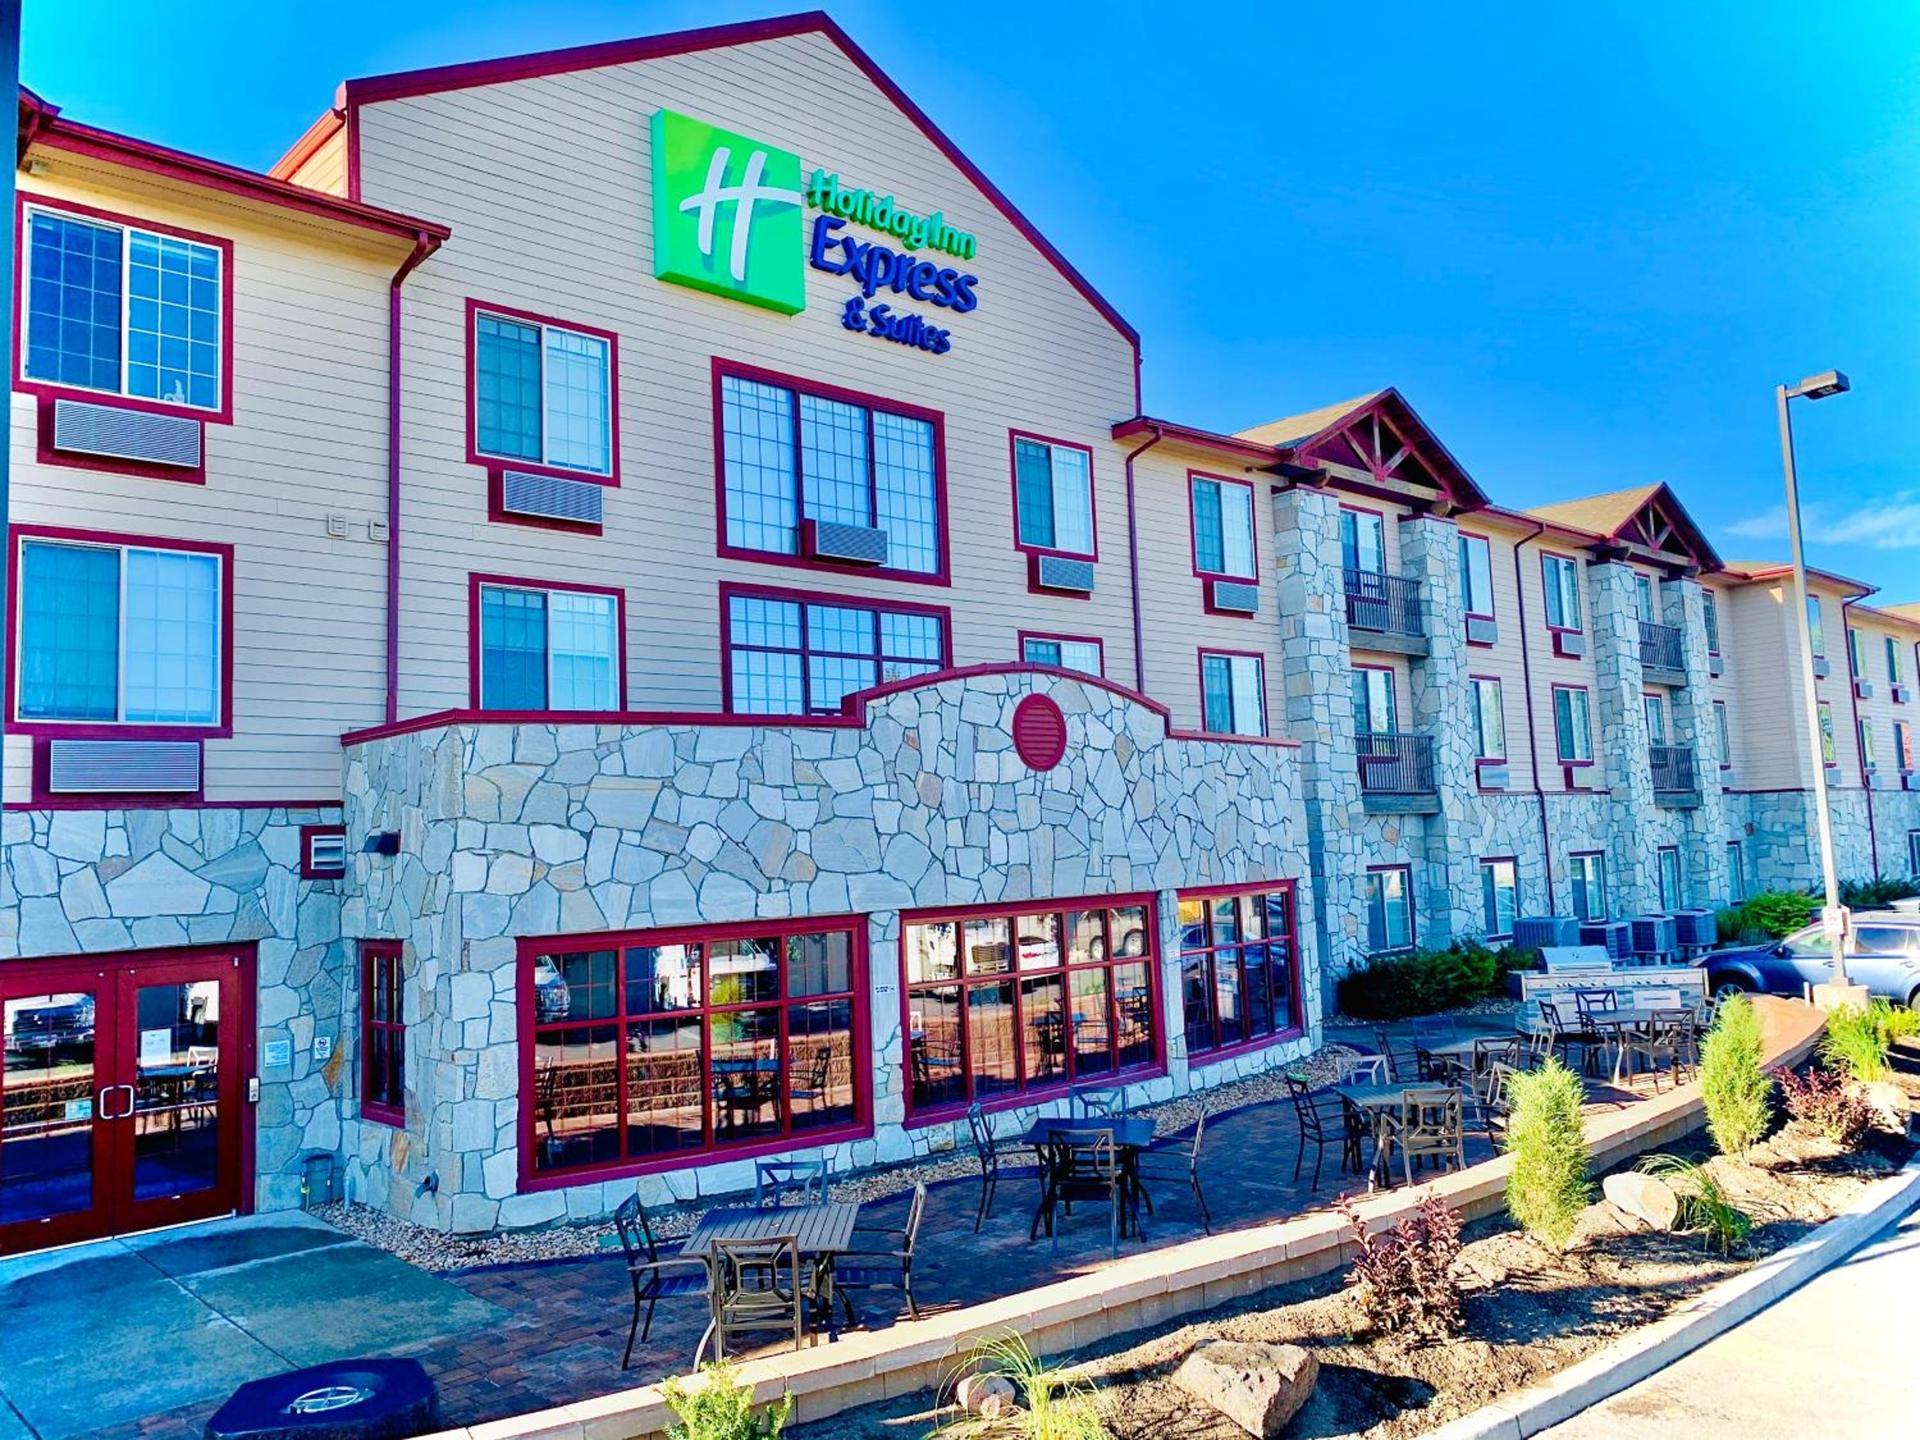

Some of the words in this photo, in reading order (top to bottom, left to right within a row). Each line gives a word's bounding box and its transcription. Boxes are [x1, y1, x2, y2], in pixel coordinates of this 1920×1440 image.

[810, 214, 978, 313] Express
[841, 296, 867, 333] &
[868, 303, 951, 355] Suites
